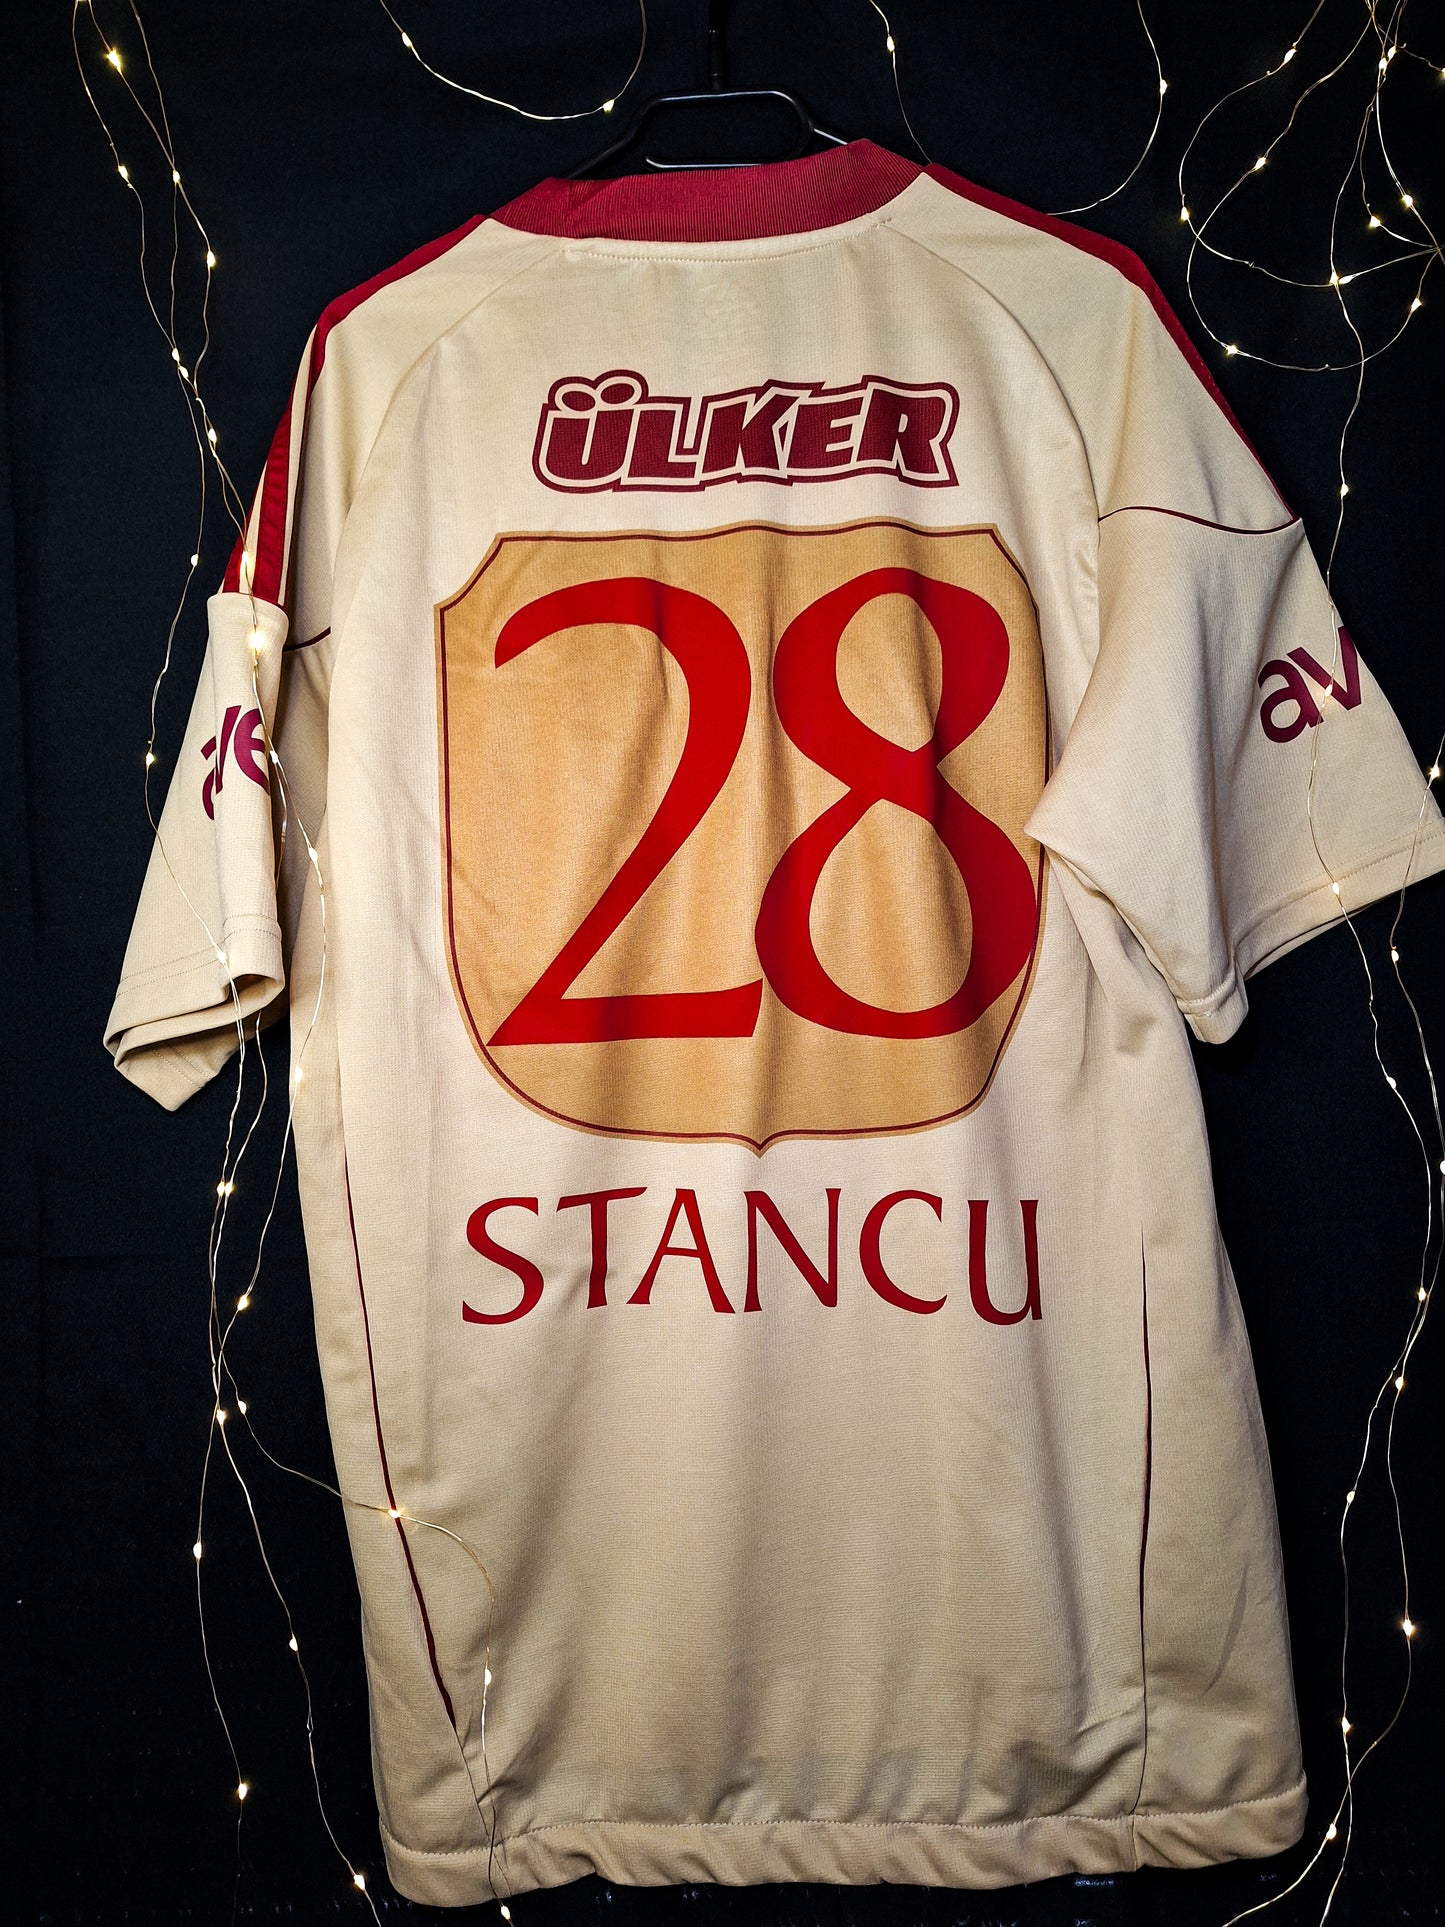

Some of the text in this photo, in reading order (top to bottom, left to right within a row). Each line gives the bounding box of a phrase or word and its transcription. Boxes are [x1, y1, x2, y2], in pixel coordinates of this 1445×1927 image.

[532, 369, 960, 494] ÜLKER
[486, 567, 1038, 1046] 28
[462, 1187, 1043, 1325] STANCU
